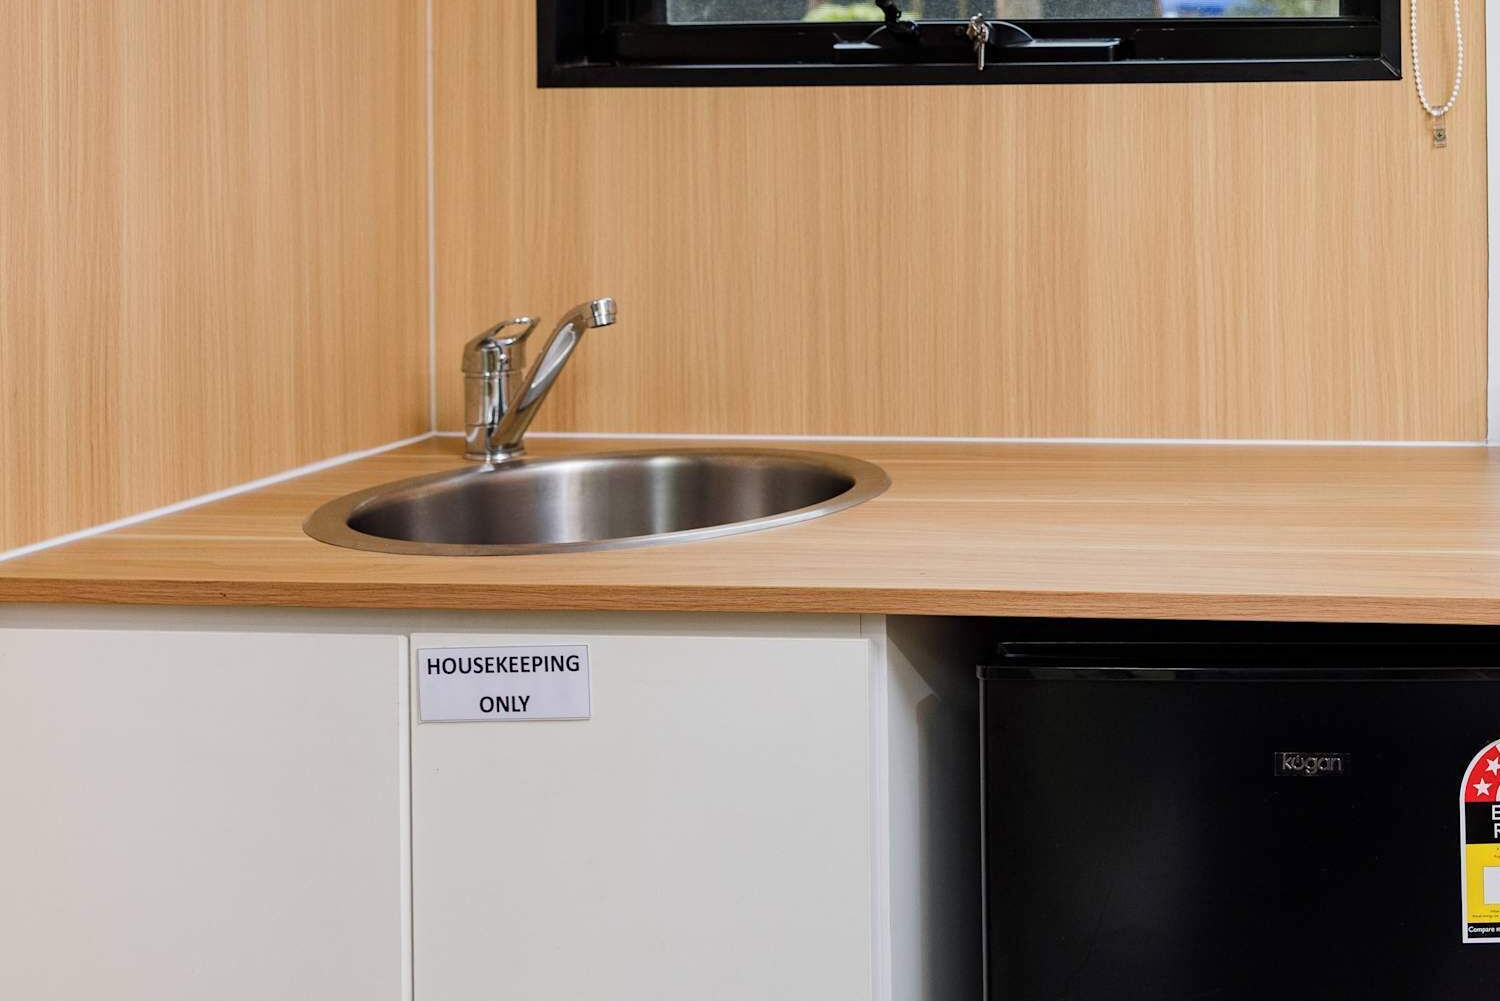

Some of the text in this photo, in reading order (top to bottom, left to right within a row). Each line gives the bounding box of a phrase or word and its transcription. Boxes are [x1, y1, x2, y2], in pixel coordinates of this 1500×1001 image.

[427, 654, 580, 675] HOUSEKEEPING
[479, 695, 530, 713] ONLY
[1281, 752, 1342, 774] kogan
[1468, 926, 1496, 935] Compare
